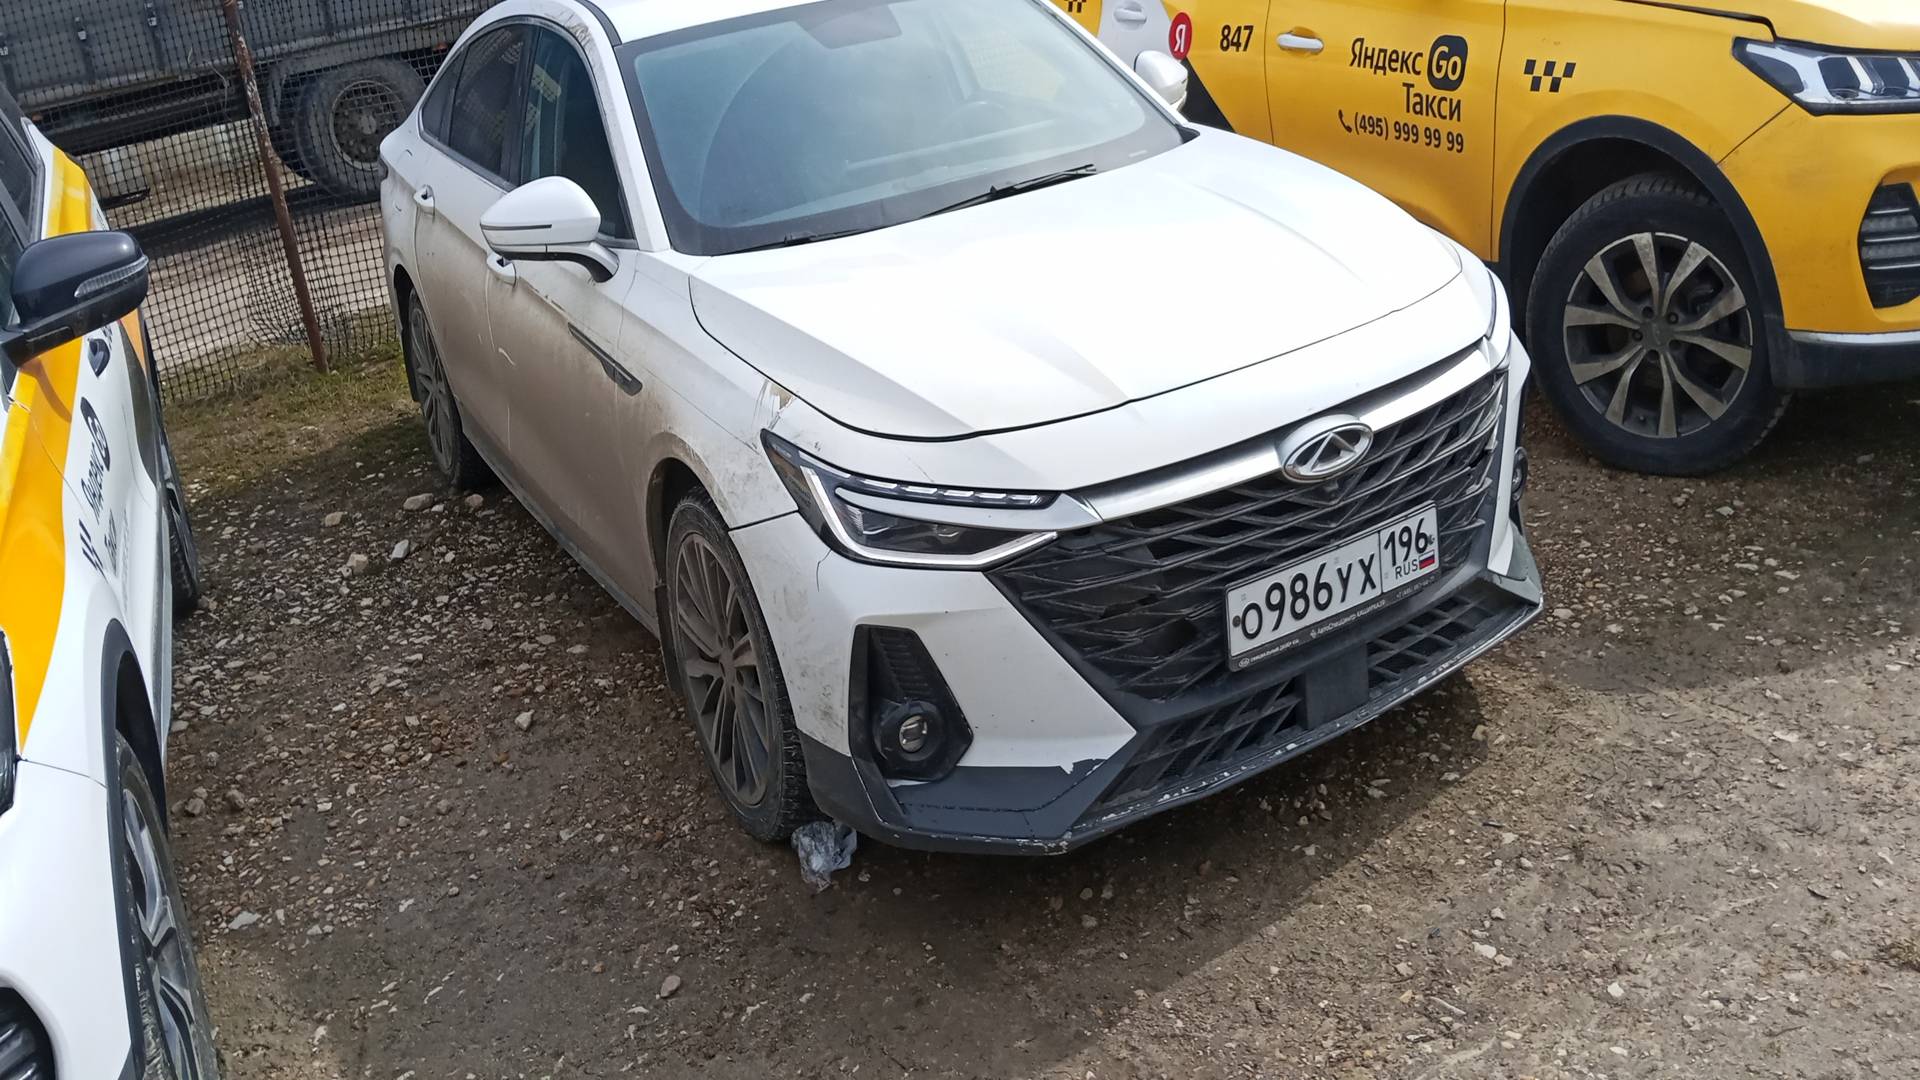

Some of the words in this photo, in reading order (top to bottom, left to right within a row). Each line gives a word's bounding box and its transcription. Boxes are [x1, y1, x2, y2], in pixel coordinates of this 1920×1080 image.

[1174, 24, 1187, 53] Я
[1220, 24, 1254, 52] 847
[1349, 38, 1424, 76] Яндекс
[1431, 45, 1462, 81] Go
[1402, 82, 1461, 122] Такси
[1354, 111, 1389, 141] (495)
[1393, 120, 1419, 144] 999
[1424, 126, 1441, 149] 99
[1446, 131, 1464, 154] 99
[1383, 517, 1429, 568] 196
[1394, 558, 1418, 580] RUS
